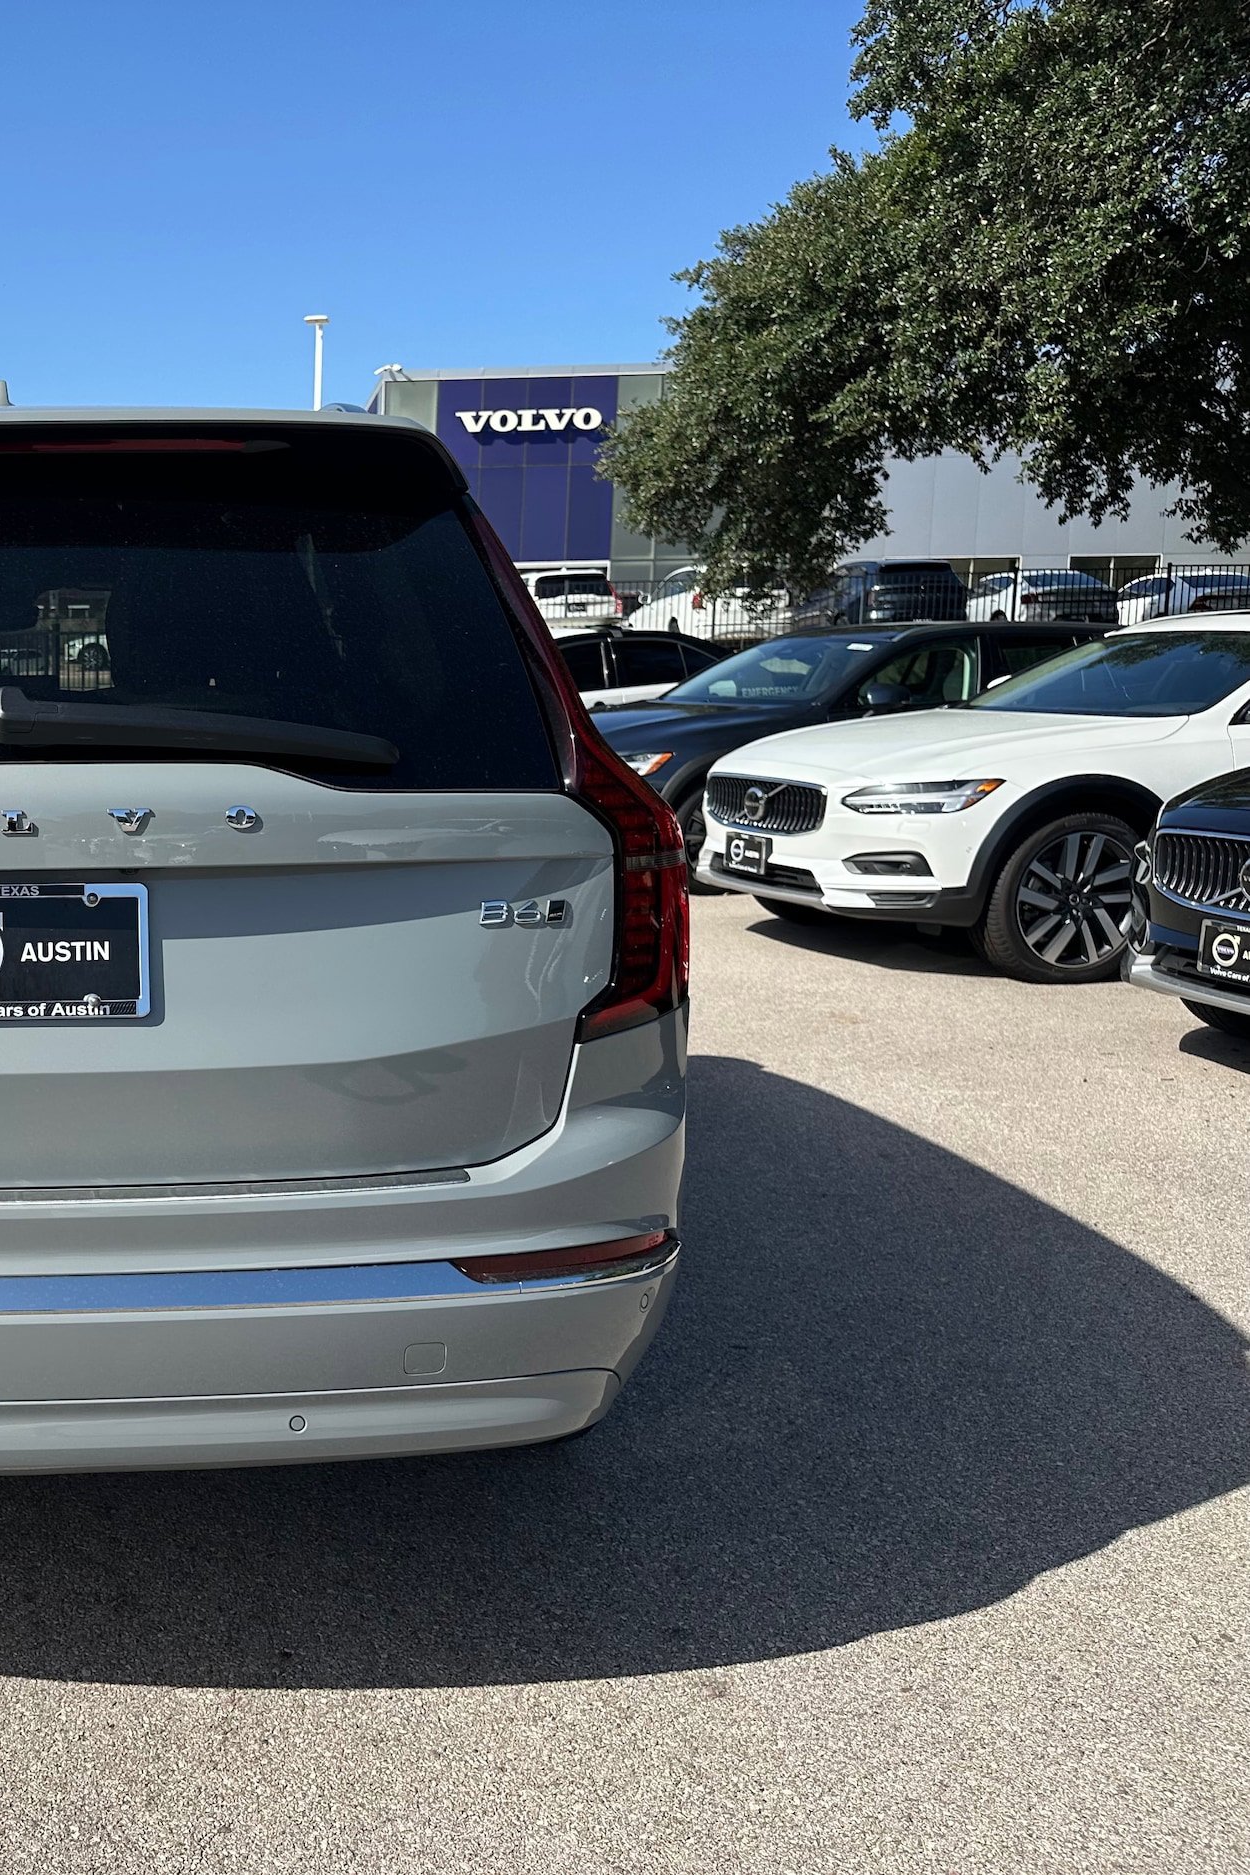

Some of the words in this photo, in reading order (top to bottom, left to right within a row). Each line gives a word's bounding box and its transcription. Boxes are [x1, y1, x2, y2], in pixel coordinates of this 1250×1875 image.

[455, 407, 602, 433] VOLVO
[479, 900, 542, 925] B6
[21, 941, 110, 962] AUSTIN
[1227, 971, 1241, 980] Cars
[28, 1002, 47, 1017] of
[51, 1002, 111, 1016] Austin
